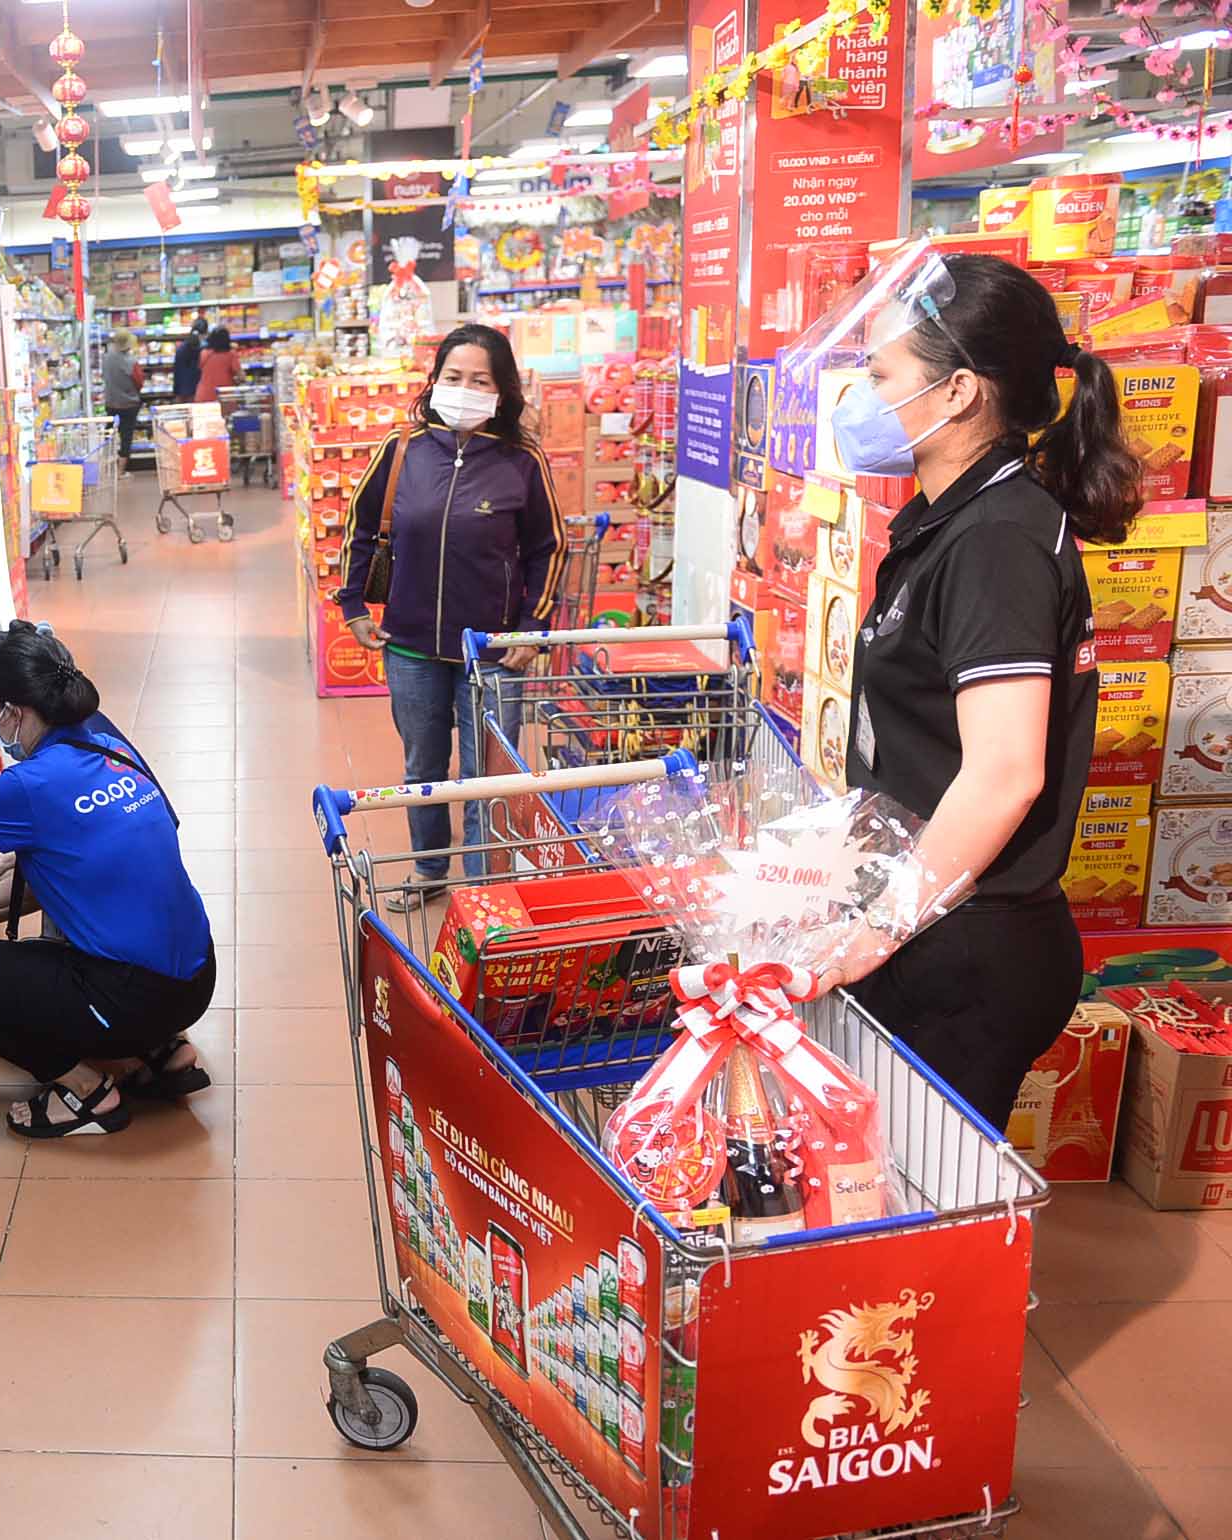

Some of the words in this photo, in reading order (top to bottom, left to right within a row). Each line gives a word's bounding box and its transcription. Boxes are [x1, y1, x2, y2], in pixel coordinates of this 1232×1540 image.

[846, 50, 888, 64] hàng
[839, 65, 888, 80] thành
[792, 177, 825, 189] Nhận
[828, 177, 858, 190] ngay
[783, 194, 825, 207] 20.000
[800, 210, 823, 222] cho
[795, 225, 818, 238] 100
[820, 222, 852, 236] điểm
[1123, 377, 1176, 396] LEIBNIZ
[74, 776, 137, 814] co.op
[1086, 796, 1133, 813] LEIBNIZ
[1080, 821, 1129, 838] LEIBNIZ
[428, 1106, 450, 1138] TẾT
[451, 1121, 463, 1146] ĐI
[464, 1135, 489, 1171] LÊN
[490, 1156, 531, 1199] CÙNG
[532, 1185, 574, 1233] NHAU
[468, 1164, 488, 1196] LON
[828, 1422, 880, 1451] BIA
[767, 1436, 936, 1496] SAIGON
